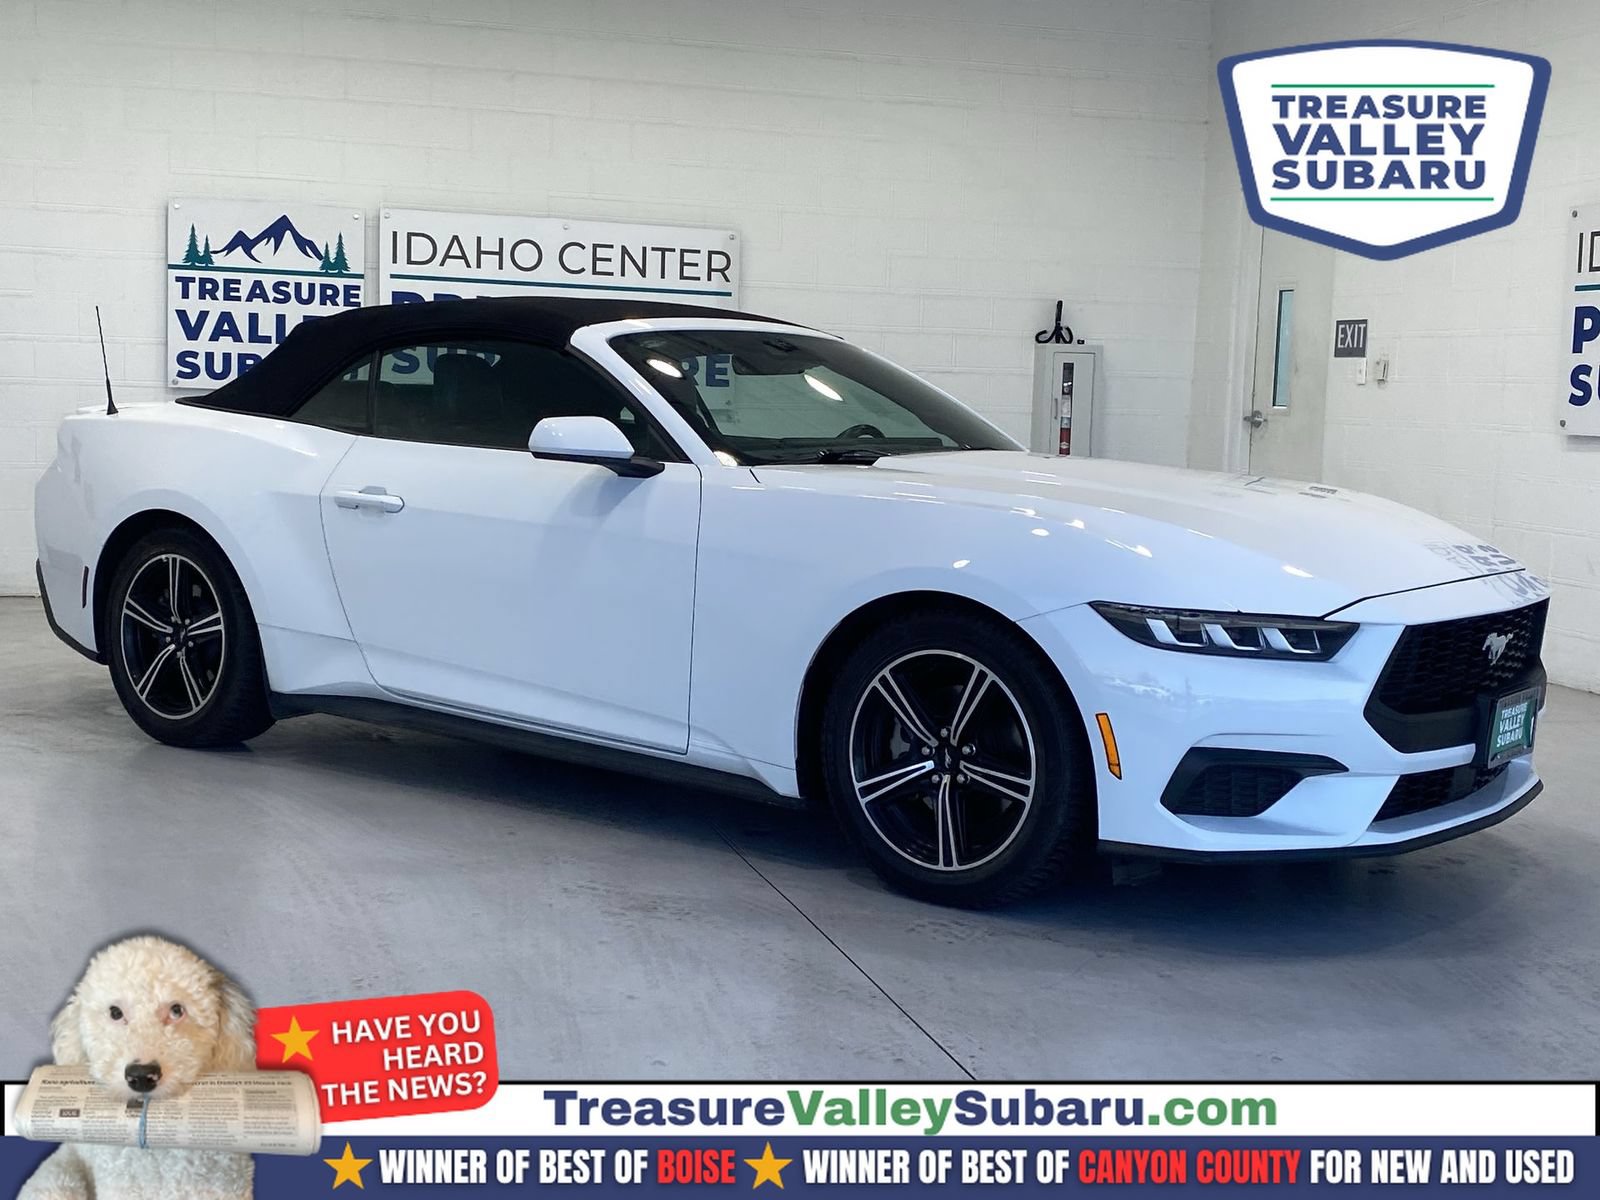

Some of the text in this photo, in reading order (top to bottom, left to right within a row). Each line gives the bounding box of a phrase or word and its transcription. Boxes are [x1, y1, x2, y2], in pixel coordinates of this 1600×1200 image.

[391, 230, 733, 283] IDAHO CENTER
[175, 275, 362, 308] TREASURE
[175, 308, 325, 344] VALL
[1337, 323, 1366, 348] EXIT
[1497, 726, 1523, 747] SUBARU
[1499, 712, 1526, 734] VALLEY
